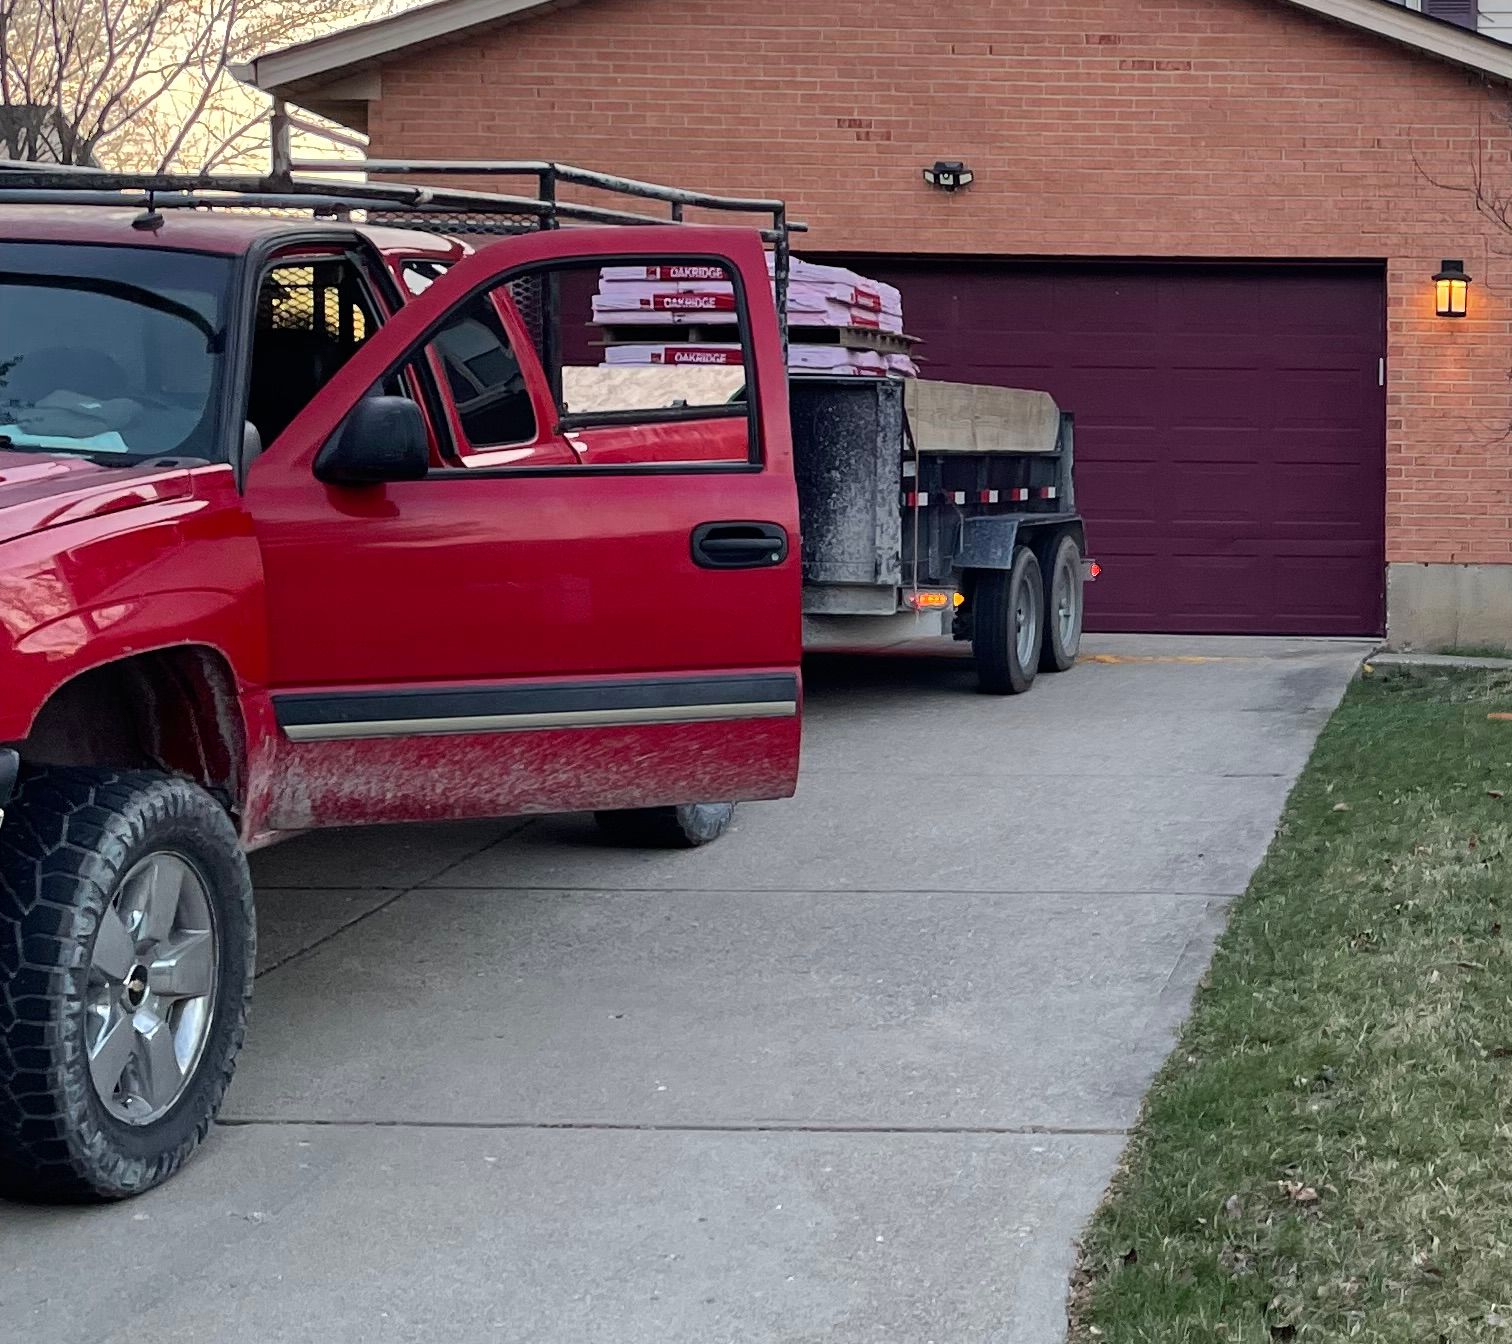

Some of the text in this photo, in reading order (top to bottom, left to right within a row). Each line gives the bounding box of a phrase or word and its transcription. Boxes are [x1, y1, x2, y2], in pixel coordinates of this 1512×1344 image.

[670, 267, 724, 279] OAKRIDGE
[663, 297, 716, 309] OAKRIDGE
[674, 352, 727, 364] OAKRIDGE
